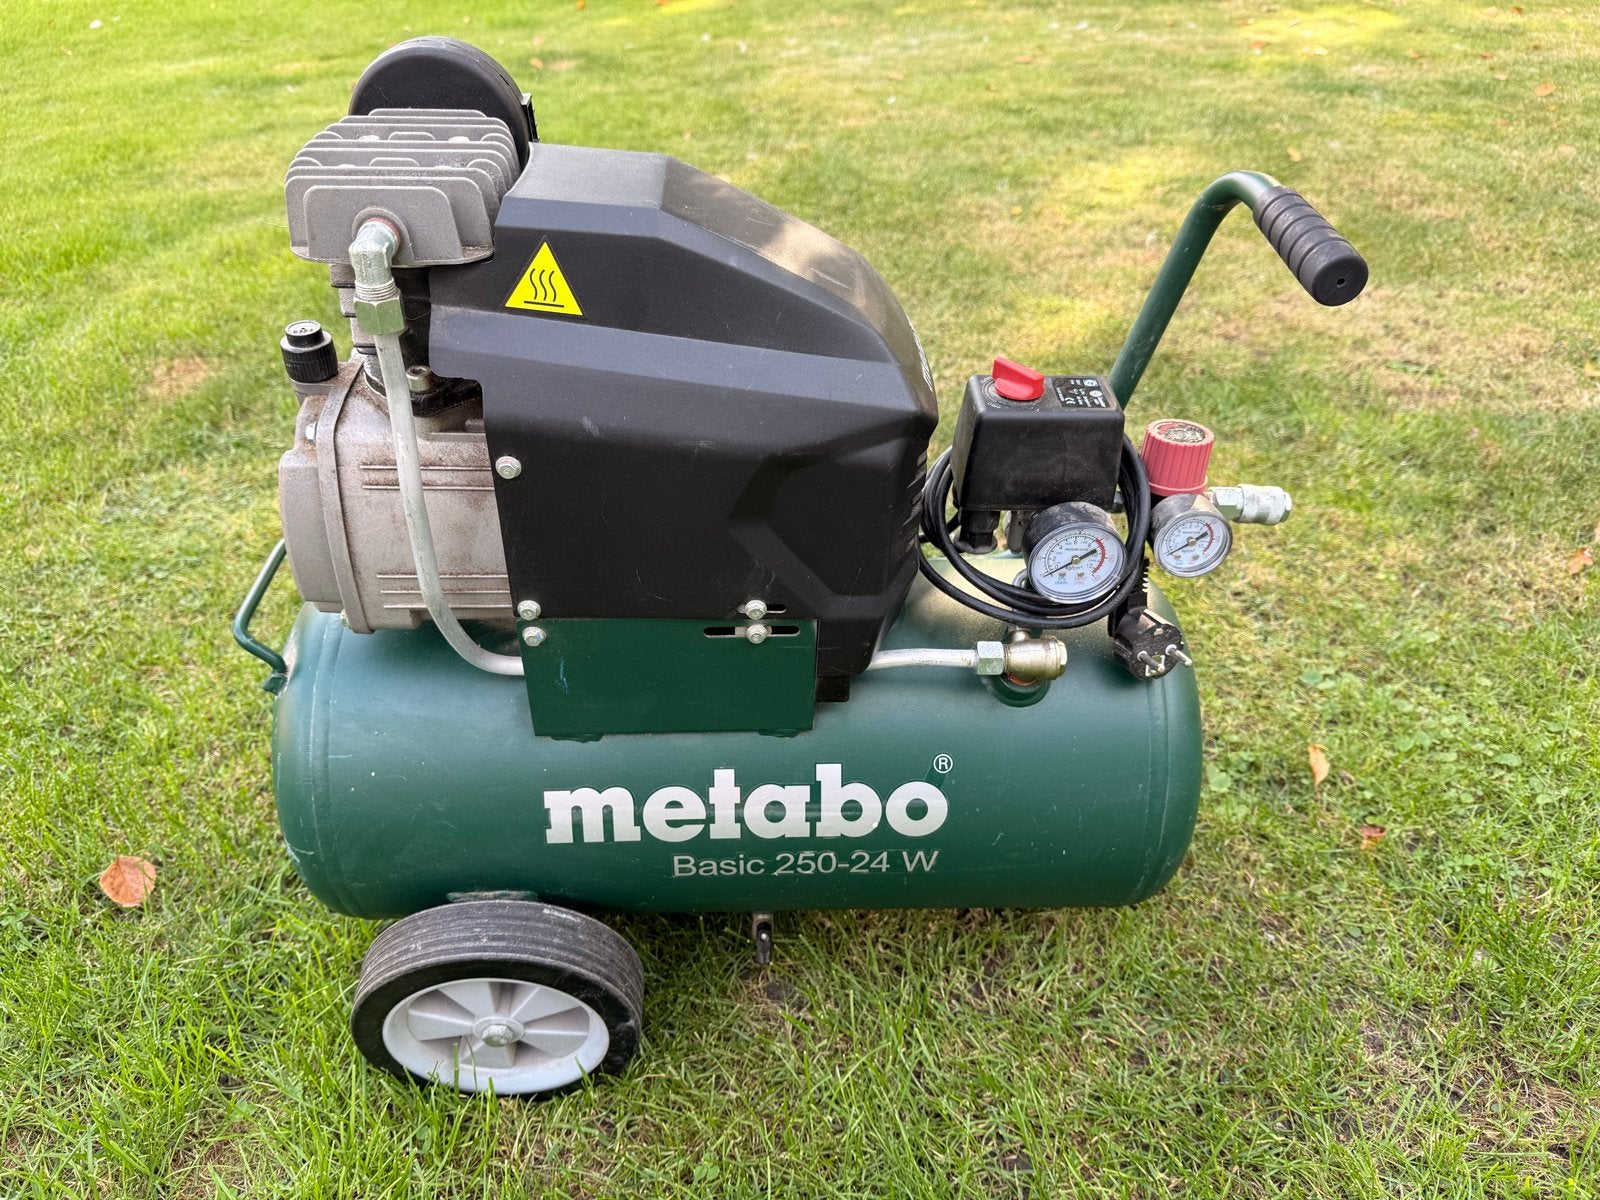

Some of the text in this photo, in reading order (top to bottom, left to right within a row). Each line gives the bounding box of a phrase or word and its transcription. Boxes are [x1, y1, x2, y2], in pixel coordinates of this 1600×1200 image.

[543, 763, 949, 843] metabo
[672, 850, 939, 878] Basic 250-24 W
